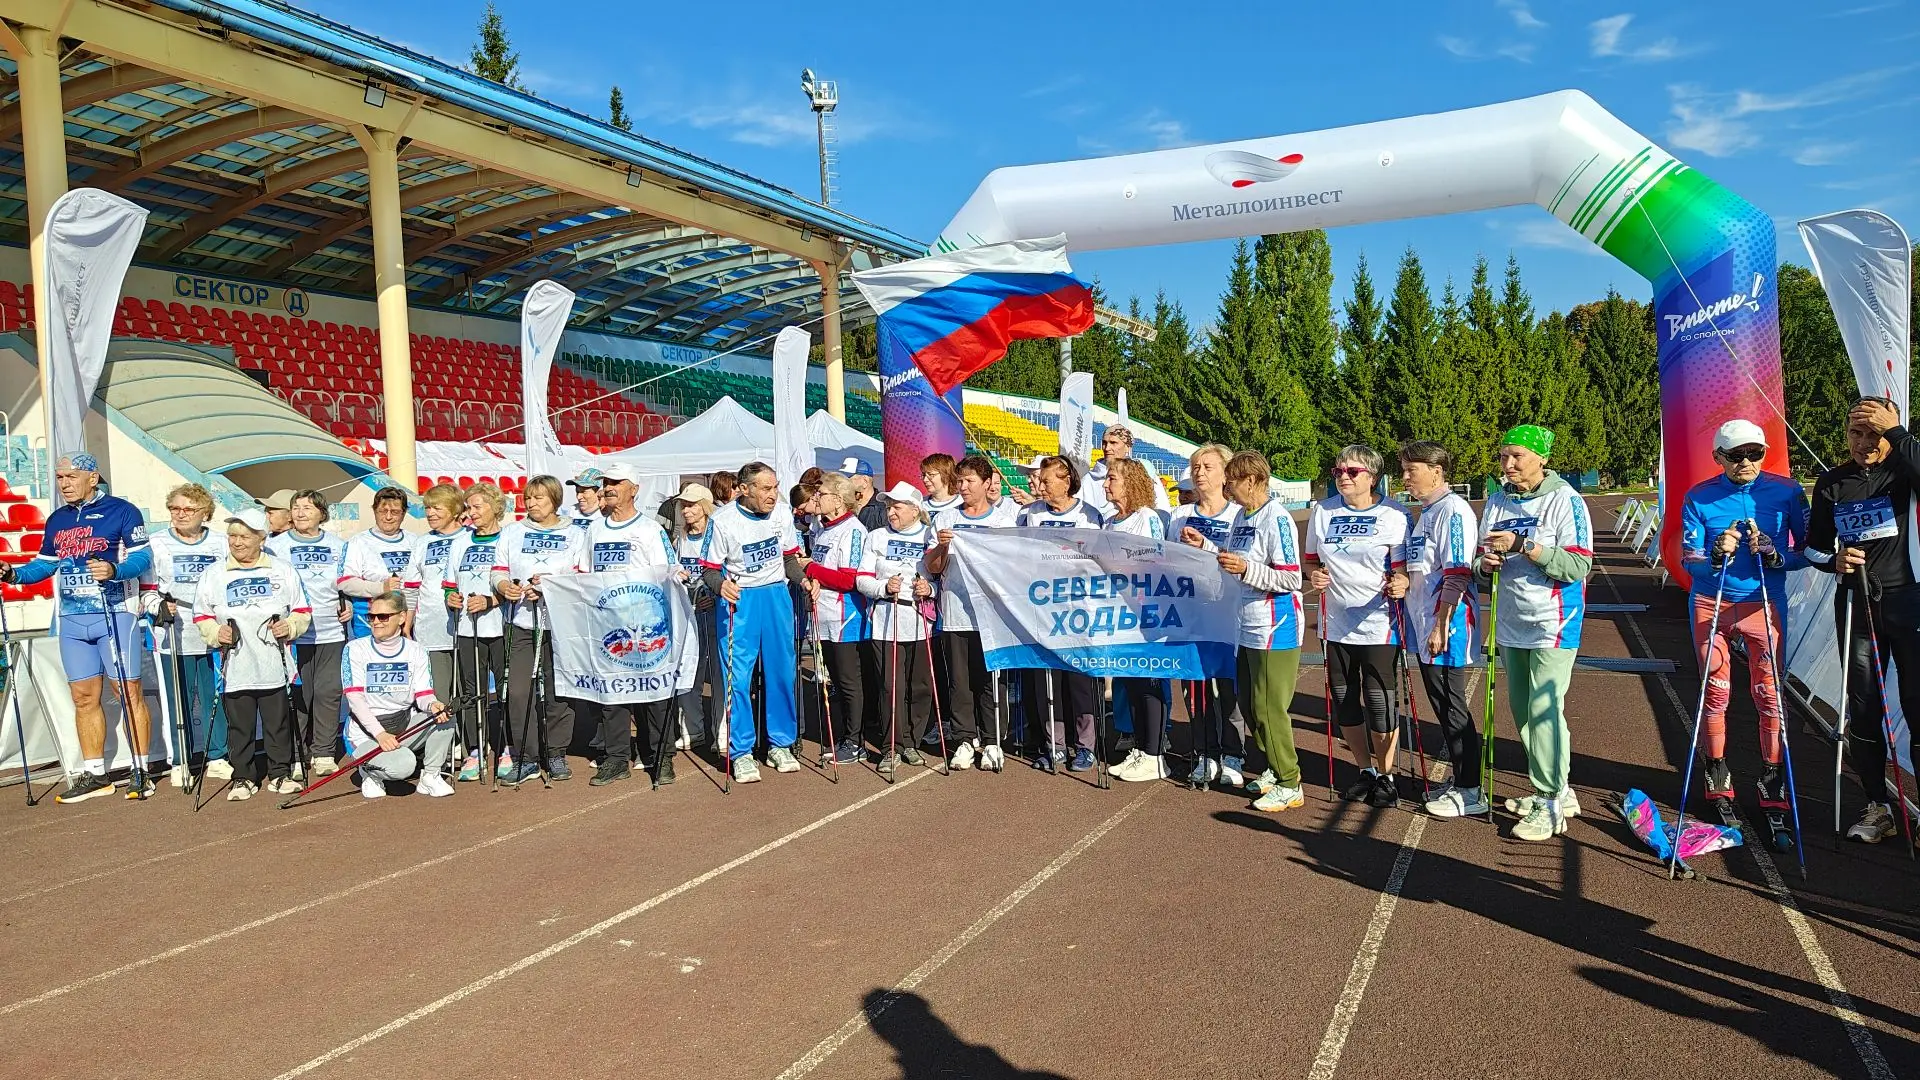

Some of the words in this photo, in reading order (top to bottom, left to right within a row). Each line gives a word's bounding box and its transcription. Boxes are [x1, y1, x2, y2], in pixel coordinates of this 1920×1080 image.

[1171, 188, 1343, 222] Металлоинвест
[175, 275, 269, 306] СЕКТОР
[289, 292, 304, 313] Д
[1664, 272, 1765, 340] Вместе!
[661, 345, 703, 363] СЕКТОР
[880, 366, 924, 396] Вмест
[1841, 511, 1884, 530] 1281
[1334, 524, 1368, 534] 1285
[529, 539, 559, 549] 1301
[296, 553, 328, 562] 1290
[431, 547, 450, 556] 129
[598, 551, 625, 562] 1278
[751, 547, 777, 562] 1288
[893, 547, 922, 557] 1257
[389, 557, 409, 565] 129
[466, 553, 495, 563] 1283
[63, 574, 94, 586] 1318
[232, 585, 266, 598] 1350
[1028, 573, 1195, 605] СЕВЕРНАЯ
[1049, 604, 1183, 637] ХОДЬБА
[373, 671, 405, 682] 1275
